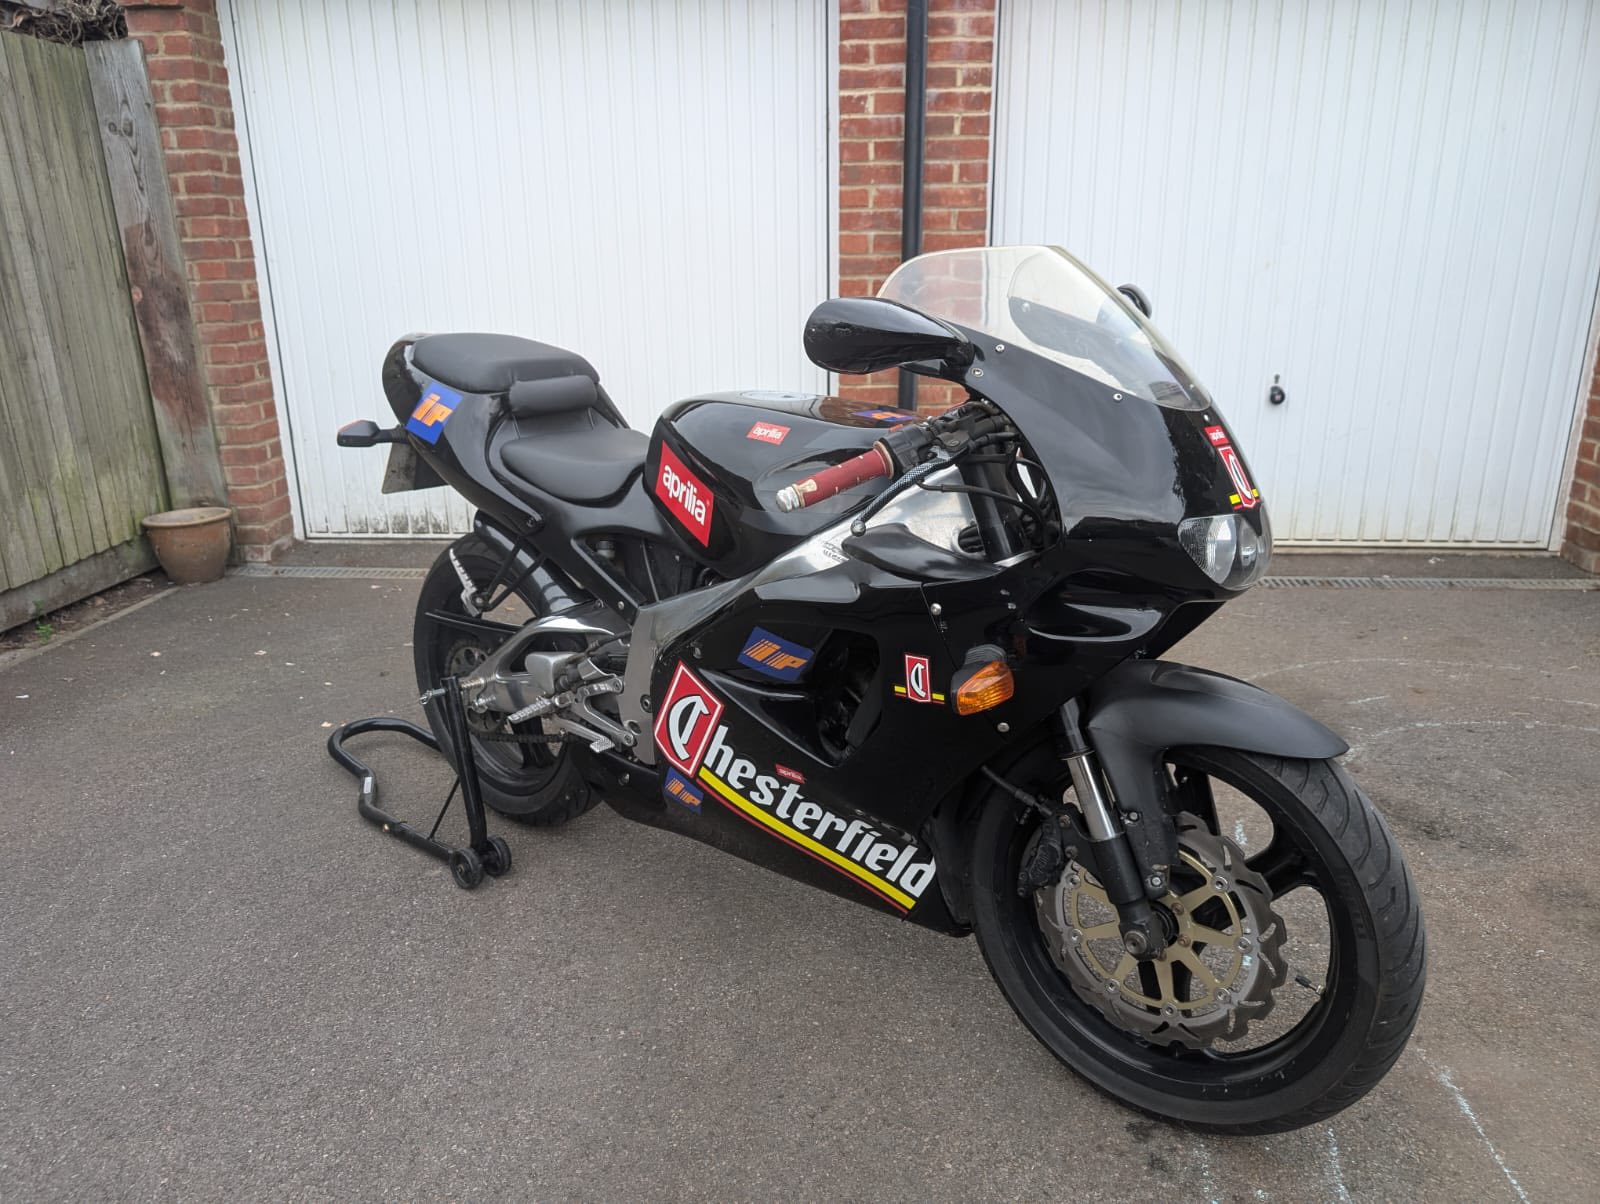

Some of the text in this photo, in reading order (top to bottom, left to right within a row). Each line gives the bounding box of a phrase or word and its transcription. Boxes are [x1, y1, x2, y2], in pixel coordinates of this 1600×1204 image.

[752, 427, 782, 440] aprilia
[663, 465, 707, 527] aprilia
[669, 695, 936, 898] Chesterfield
